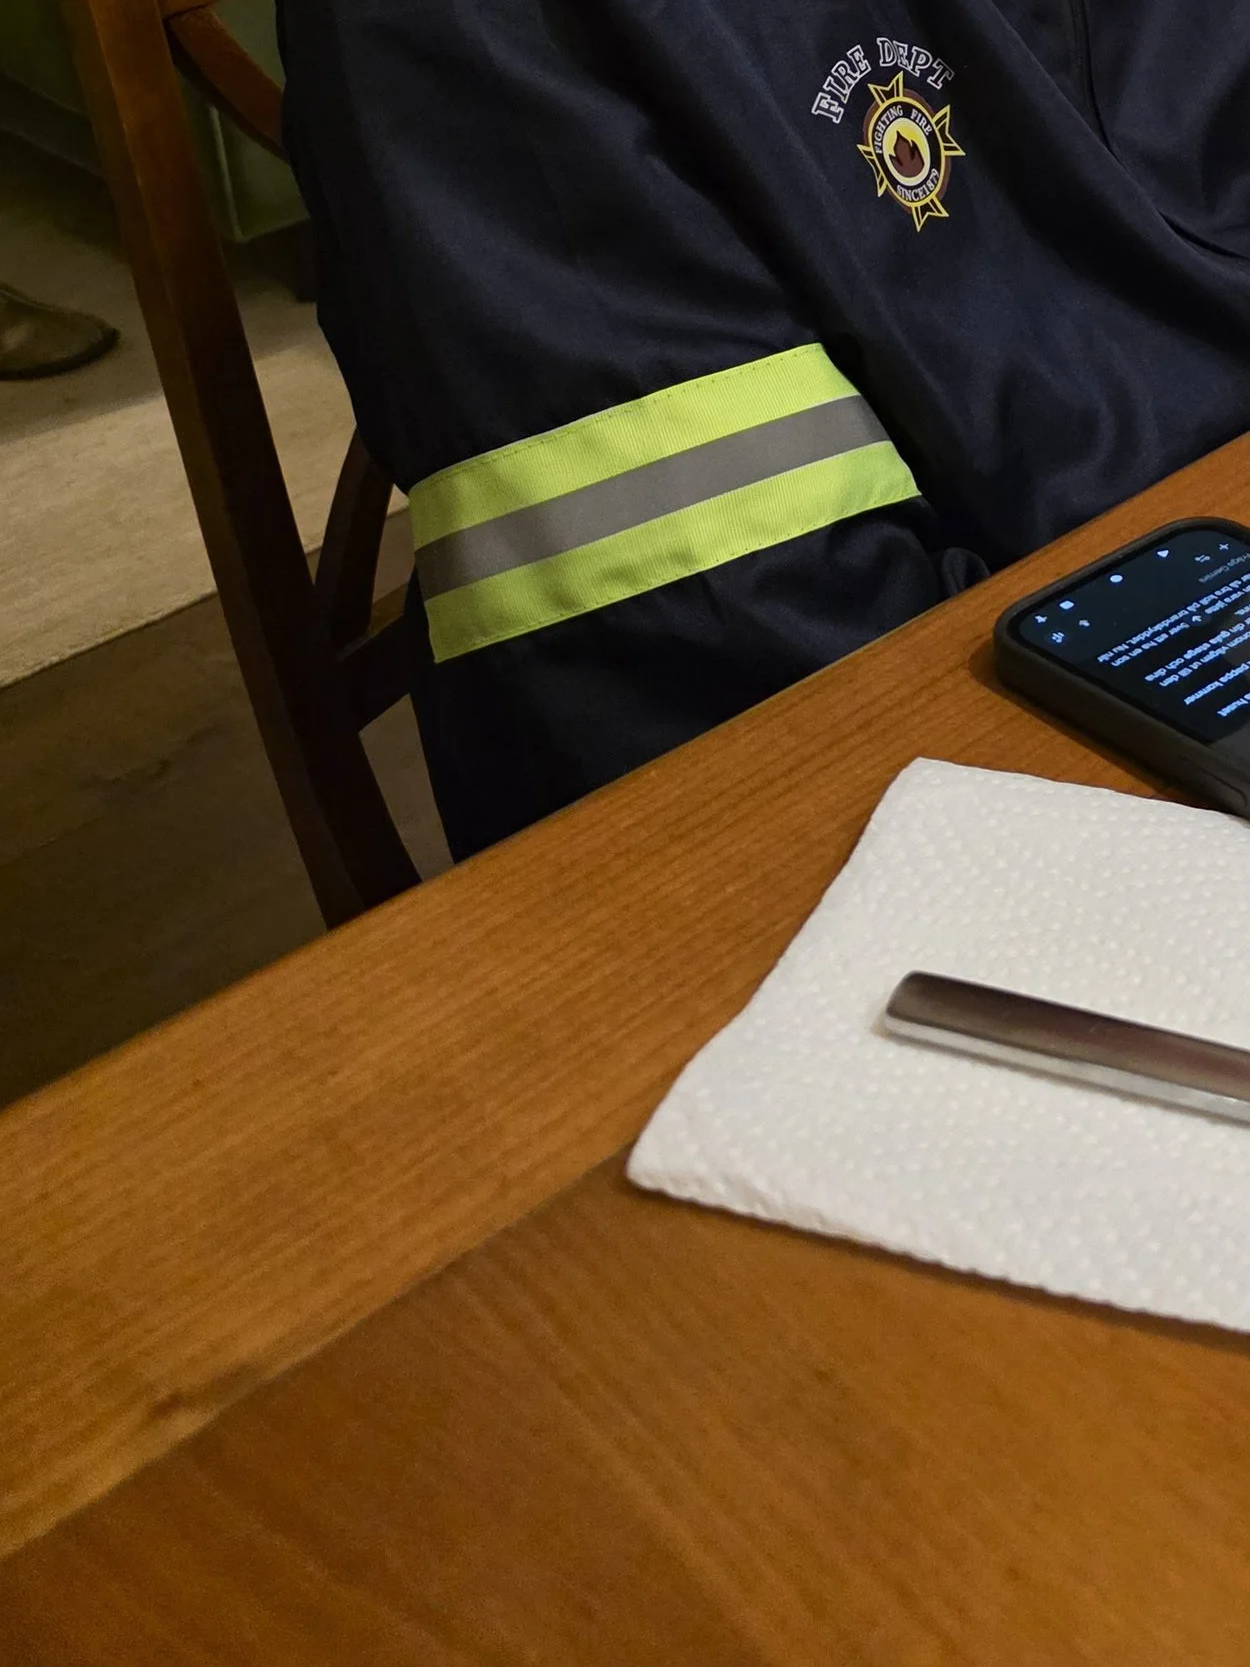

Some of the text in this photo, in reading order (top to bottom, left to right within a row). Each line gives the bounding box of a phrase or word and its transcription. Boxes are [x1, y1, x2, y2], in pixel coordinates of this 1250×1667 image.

[811, 37, 955, 124] FIRE DEPT
[873, 104, 933, 155] FIGHTING FIRE
[1229, 580, 1241, 588] så
[1215, 586, 1232, 595] bra
[1199, 594, 1218, 605] koll
[1224, 591, 1244, 602] vara
[1187, 602, 1201, 612] på
[1126, 610, 1189, 644] brandskyddet.
[1229, 623, 1245, 632] din
[1154, 633, 1168, 642] att
[1209, 631, 1230, 644] gula
[1112, 644, 1129, 653] Nu
[1141, 641, 1157, 649] ha
[1128, 648, 1142, 656] en
[1184, 643, 1211, 659] stege
[1200, 646, 1229, 662] vägen
[1098, 652, 1114, 662] när
[1111, 655, 1130, 666] son
[1165, 658, 1184, 669] och
[1145, 668, 1166, 681] dina
[1178, 668, 1192, 677] till
[1219, 663, 1249, 682] pappa
[1160, 675, 1179, 686] den
[1184, 681, 1223, 705] kommer
[1217, 699, 1248, 716] huset
